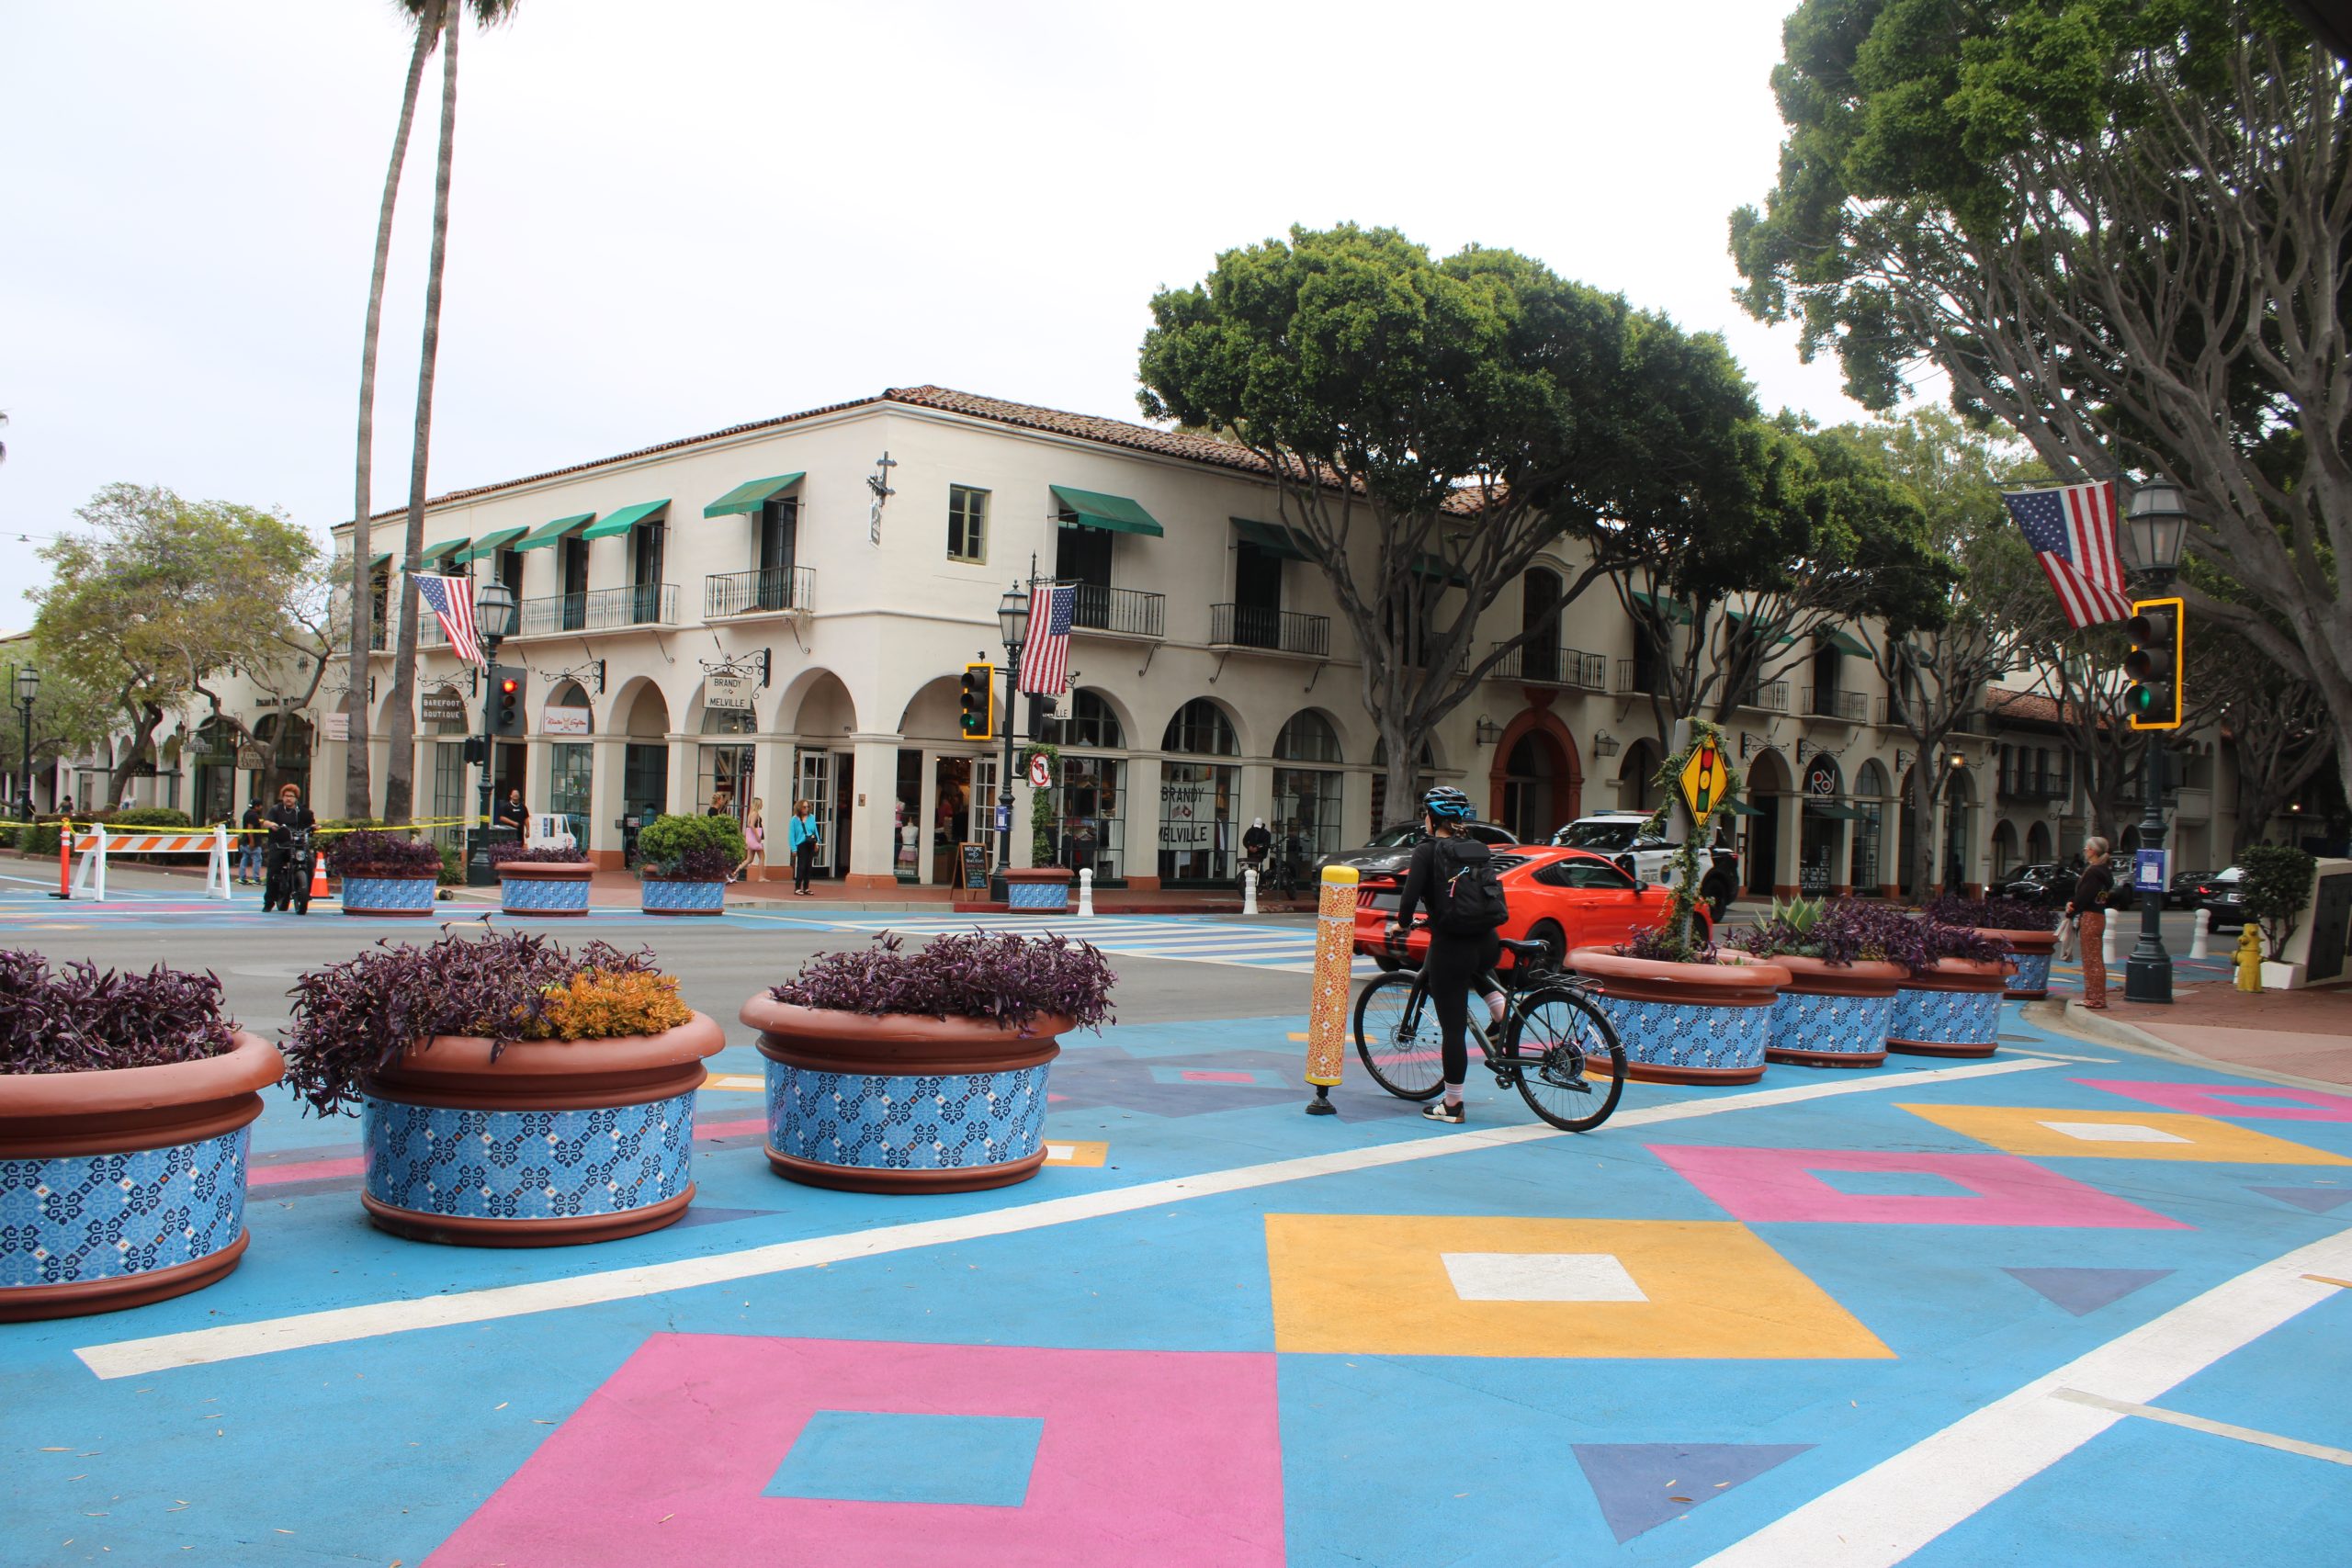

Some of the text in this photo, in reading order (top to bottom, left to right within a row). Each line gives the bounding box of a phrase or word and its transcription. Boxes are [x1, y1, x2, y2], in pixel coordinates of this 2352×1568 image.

[714, 678, 741, 687] BRANDY
[709, 698, 745, 707] MELVILLE
[424, 710, 460, 718] BOUTIQUE
[1161, 786, 1204, 803] BRANDY
